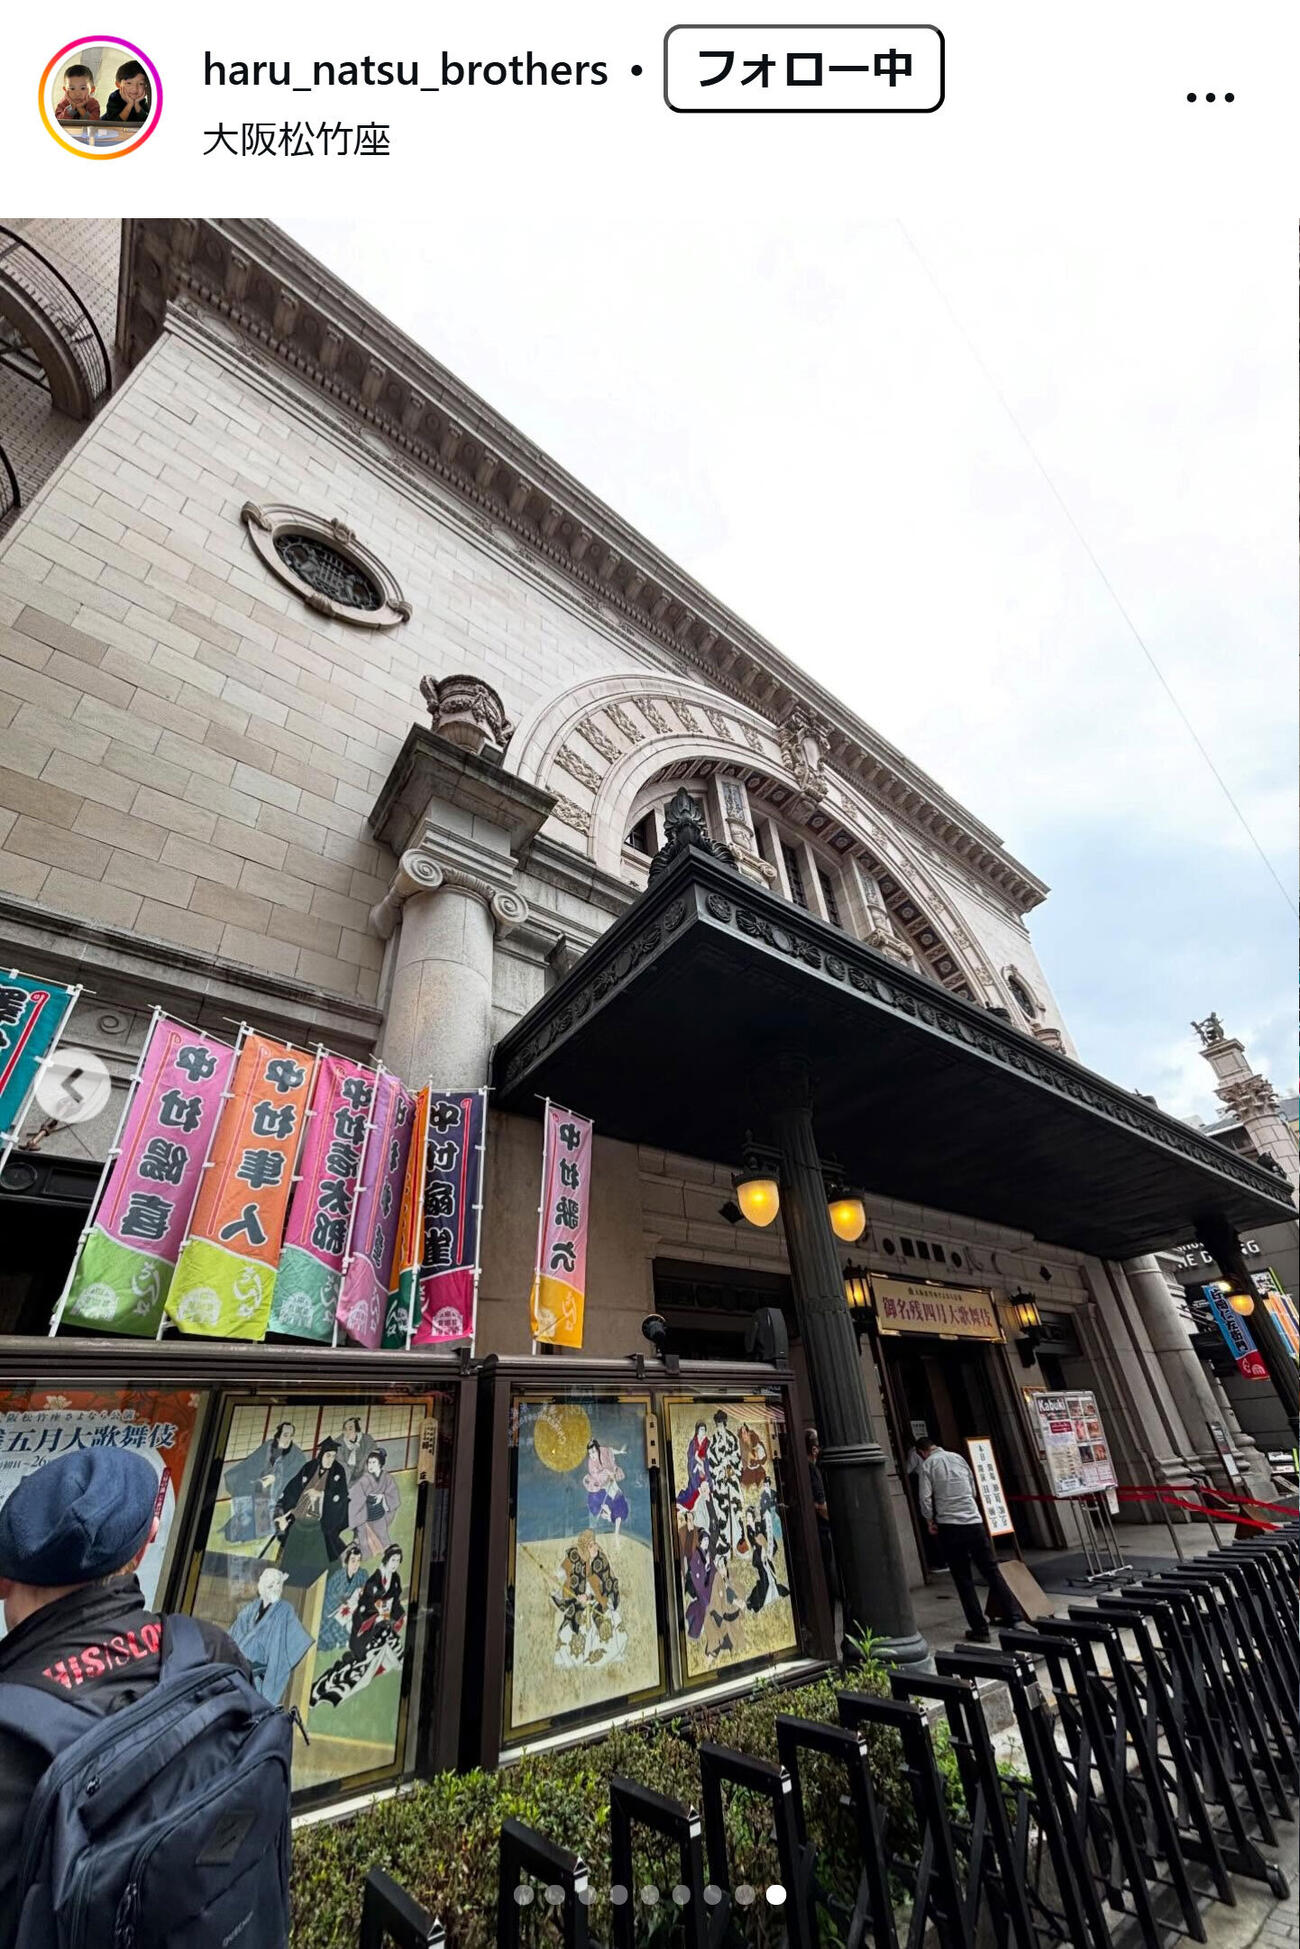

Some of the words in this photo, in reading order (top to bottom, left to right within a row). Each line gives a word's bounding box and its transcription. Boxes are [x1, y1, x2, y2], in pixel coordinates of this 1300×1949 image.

[0, 1410, 136, 1424] 阪松竹座さよなら公演
[0, 1423, 179, 1453] 五月大歌舞伎
